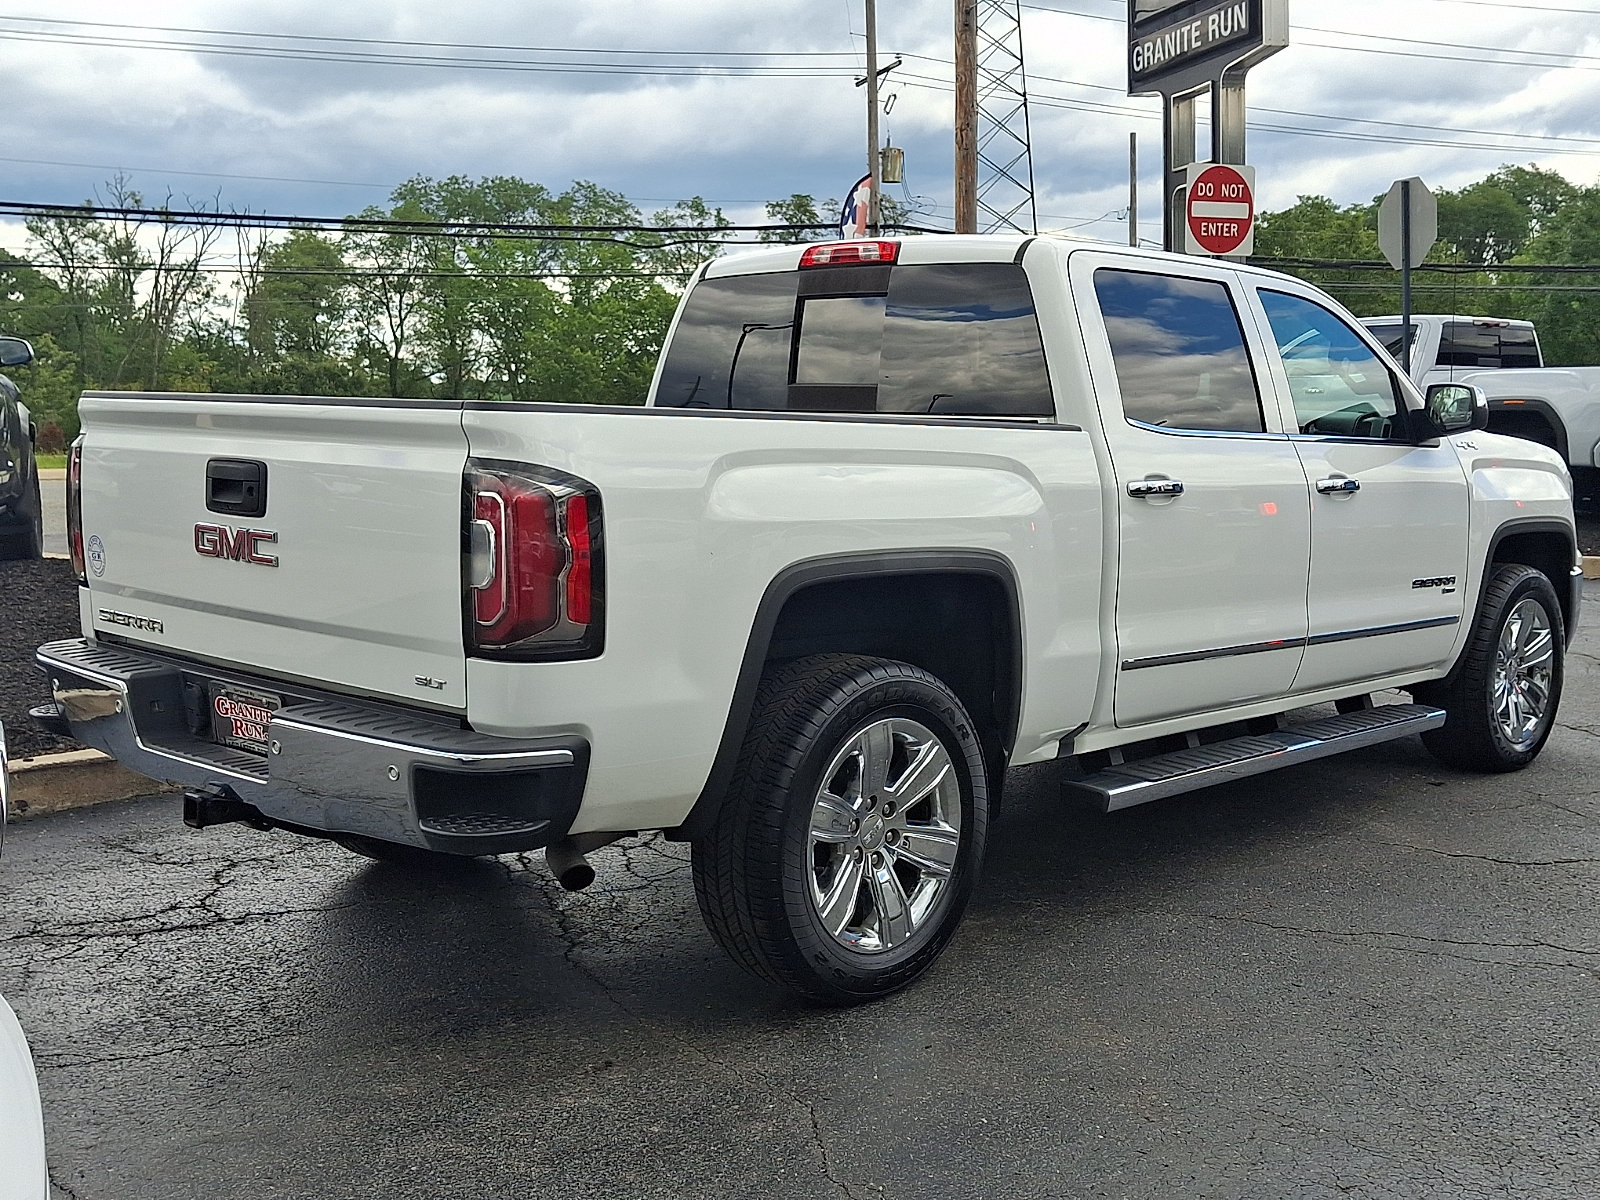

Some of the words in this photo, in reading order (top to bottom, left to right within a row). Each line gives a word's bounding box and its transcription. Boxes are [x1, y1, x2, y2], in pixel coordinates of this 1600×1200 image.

[1132, 19, 1202, 73] GRANITE
[1208, 1, 1247, 42] RUN
[1197, 182, 1214, 197] DO
[1221, 184, 1245, 198] NOT
[1200, 222, 1238, 237] ENTER
[194, 521, 279, 567] GMC
[1411, 575, 1457, 590] SIERRA
[98, 607, 164, 634] SIERRA
[414, 674, 448, 691] SLT
[215, 696, 273, 725] GRANITE
